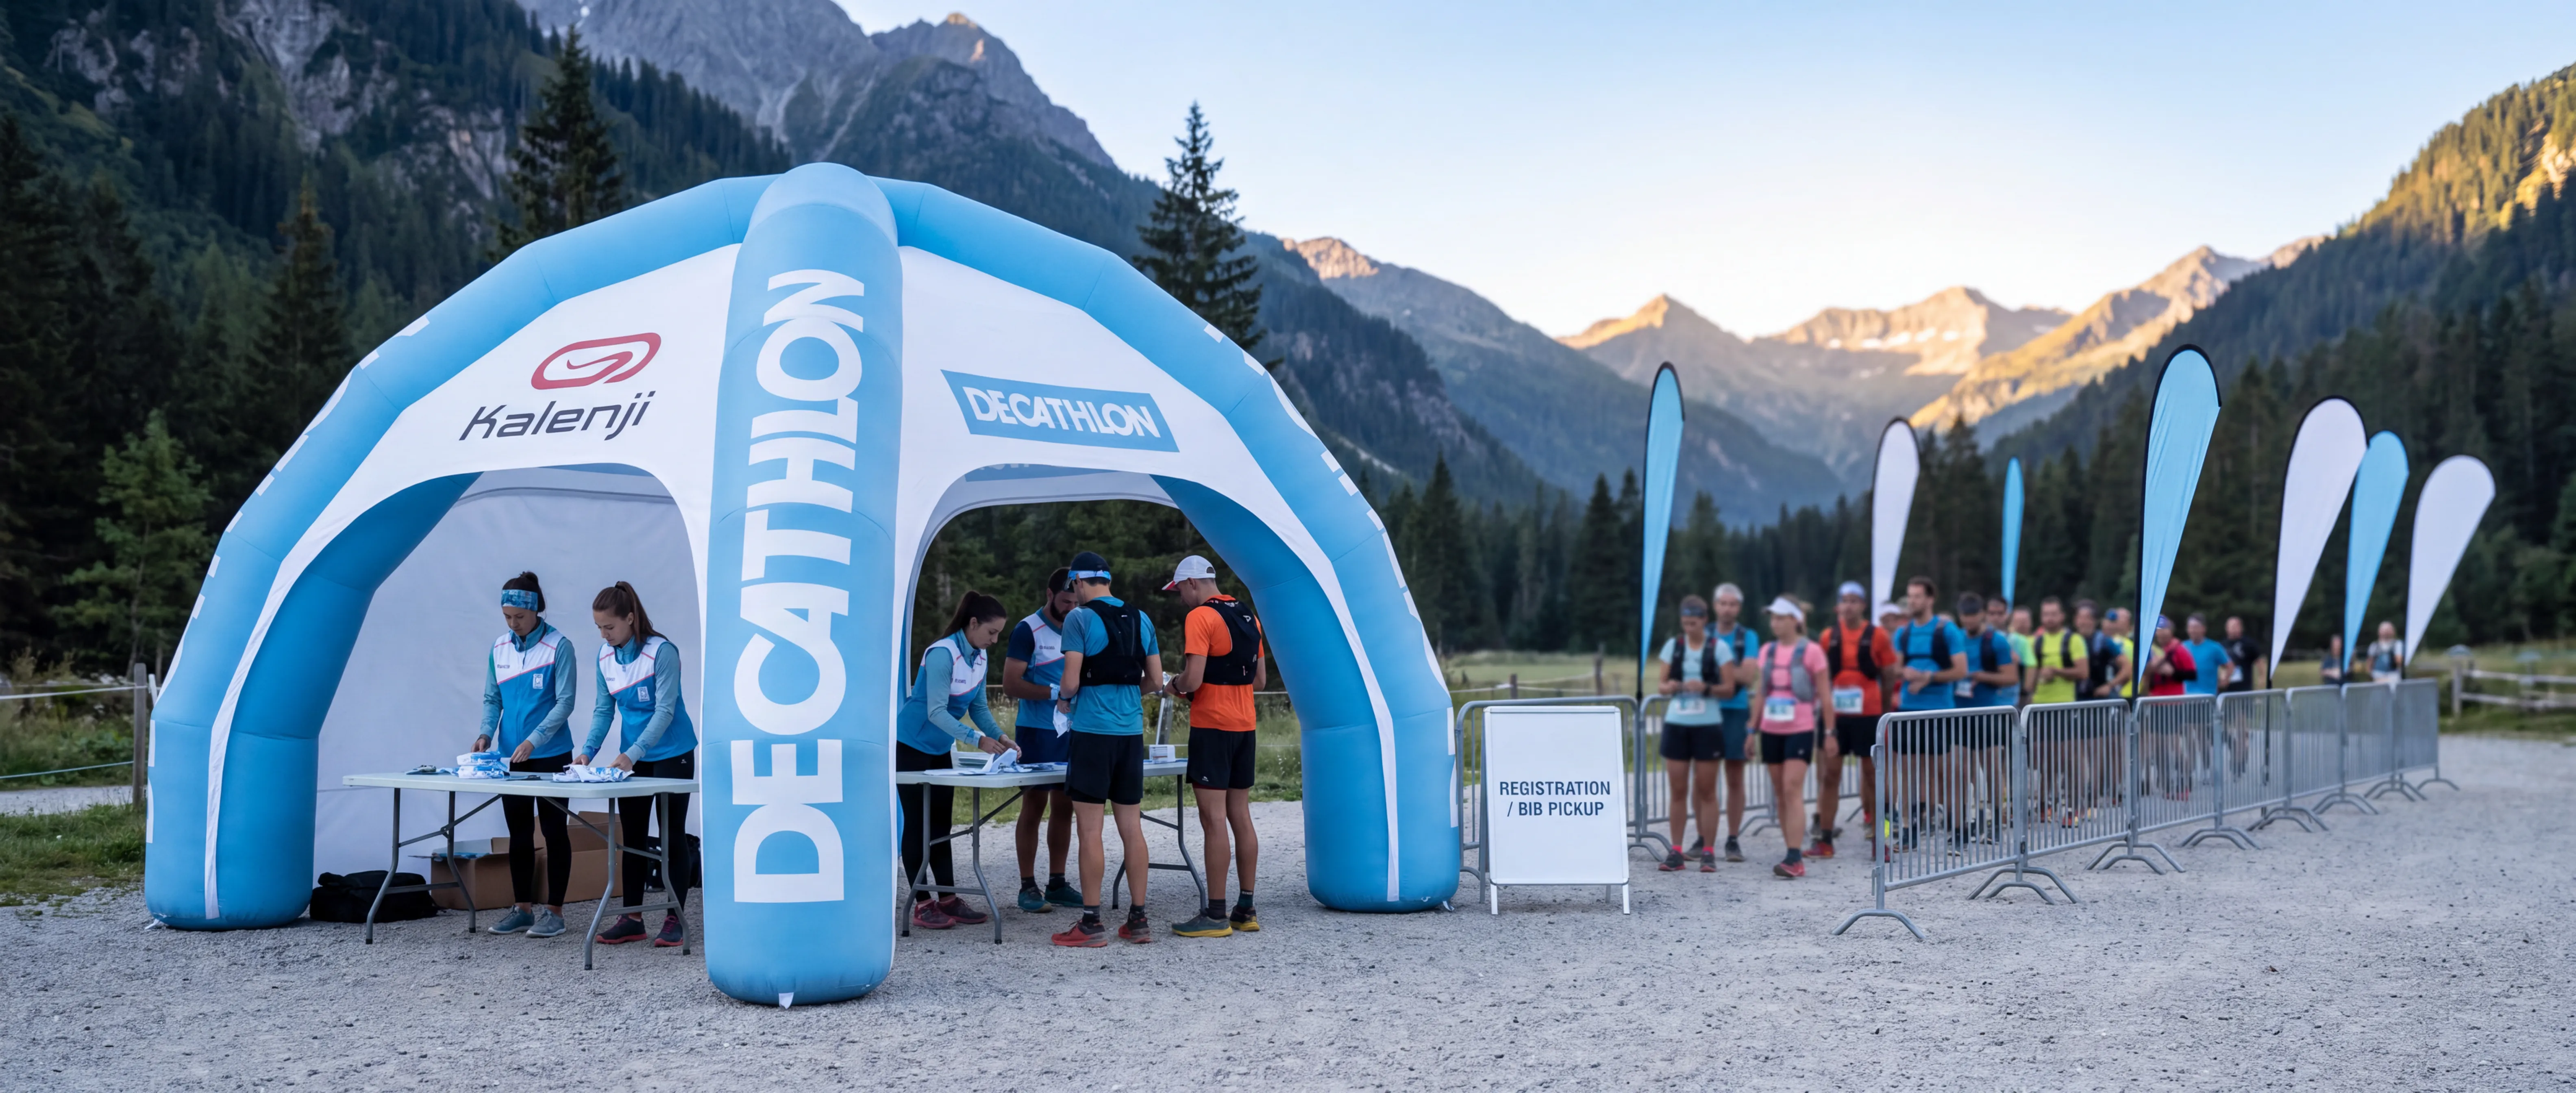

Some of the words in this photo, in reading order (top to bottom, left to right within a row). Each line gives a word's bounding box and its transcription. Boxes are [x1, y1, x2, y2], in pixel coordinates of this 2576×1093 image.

[459, 390, 656, 441] Kalenji
[962, 386, 1161, 438] DECATHLON
[731, 269, 865, 903] DECATHLON
[1499, 781, 1610, 795] REGISTRATION
[1507, 801, 1513, 817] /
[1519, 802, 1543, 816] BIB
[1549, 801, 1604, 816] PICKUP
